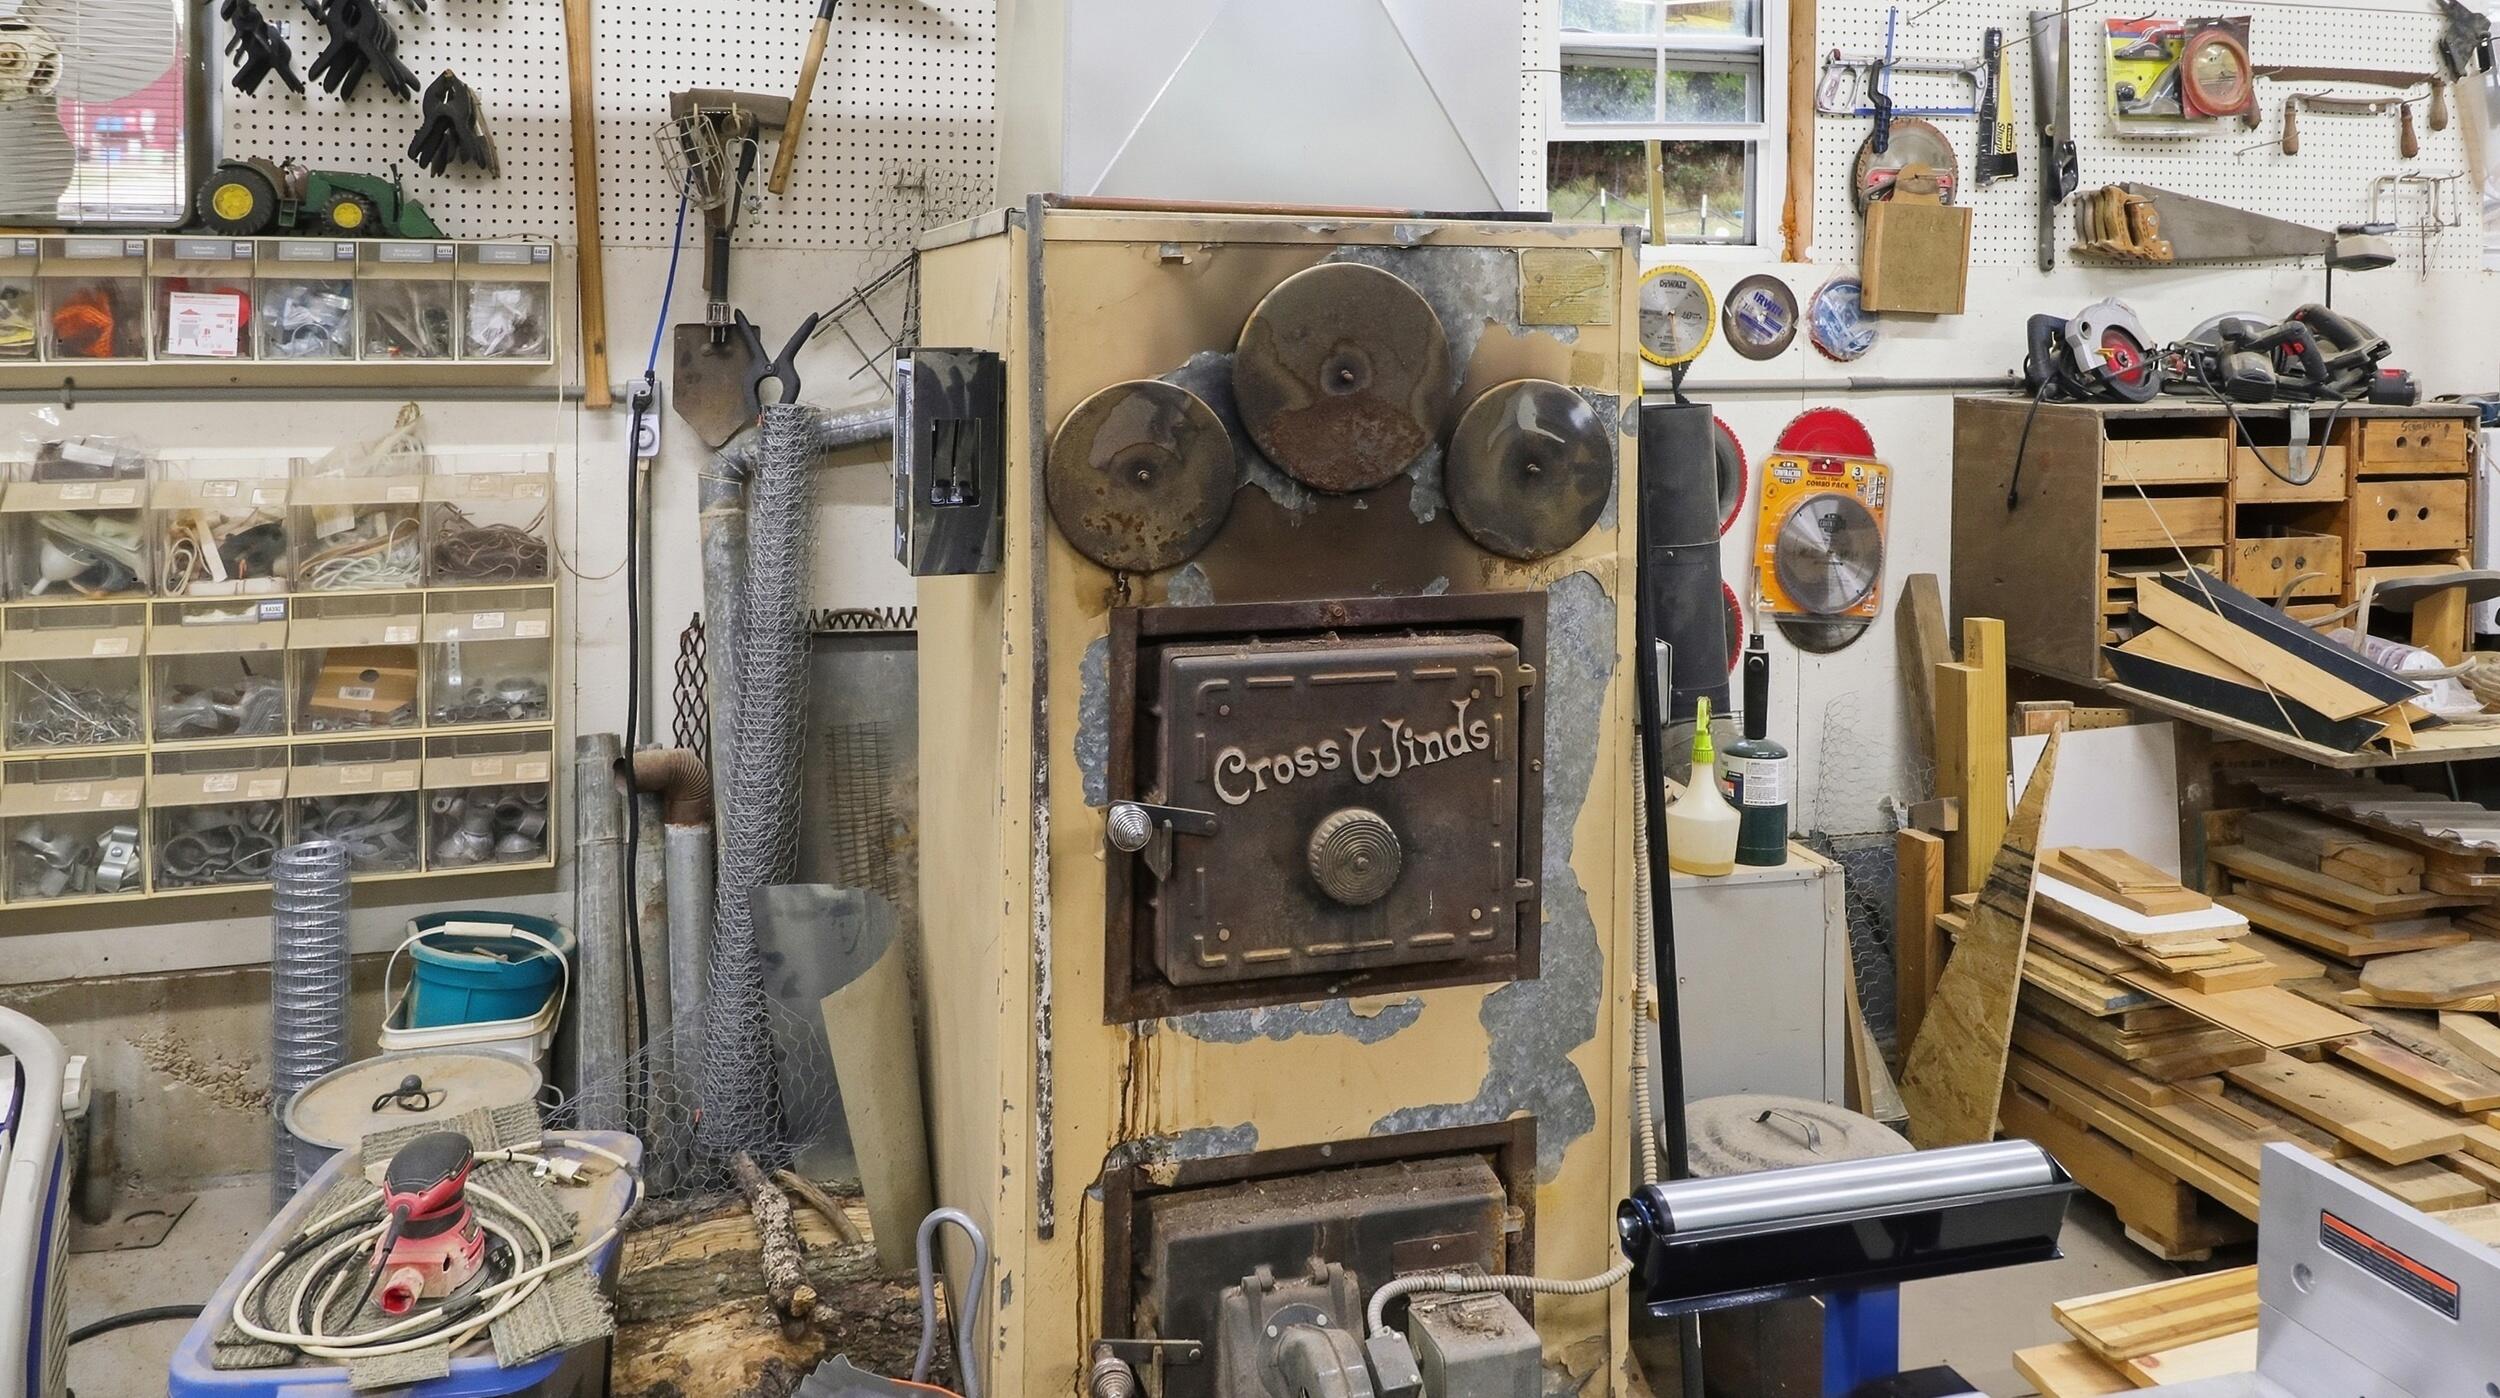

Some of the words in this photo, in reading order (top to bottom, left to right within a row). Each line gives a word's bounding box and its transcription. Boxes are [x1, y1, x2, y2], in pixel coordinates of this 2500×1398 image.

[1753, 291, 1784, 316] IRWIN
[1806, 480, 1831, 488] COMBO
[1832, 481, 1849, 489] PACK
[1213, 739, 1342, 805] Cross
[1345, 698, 1490, 784] Winds
